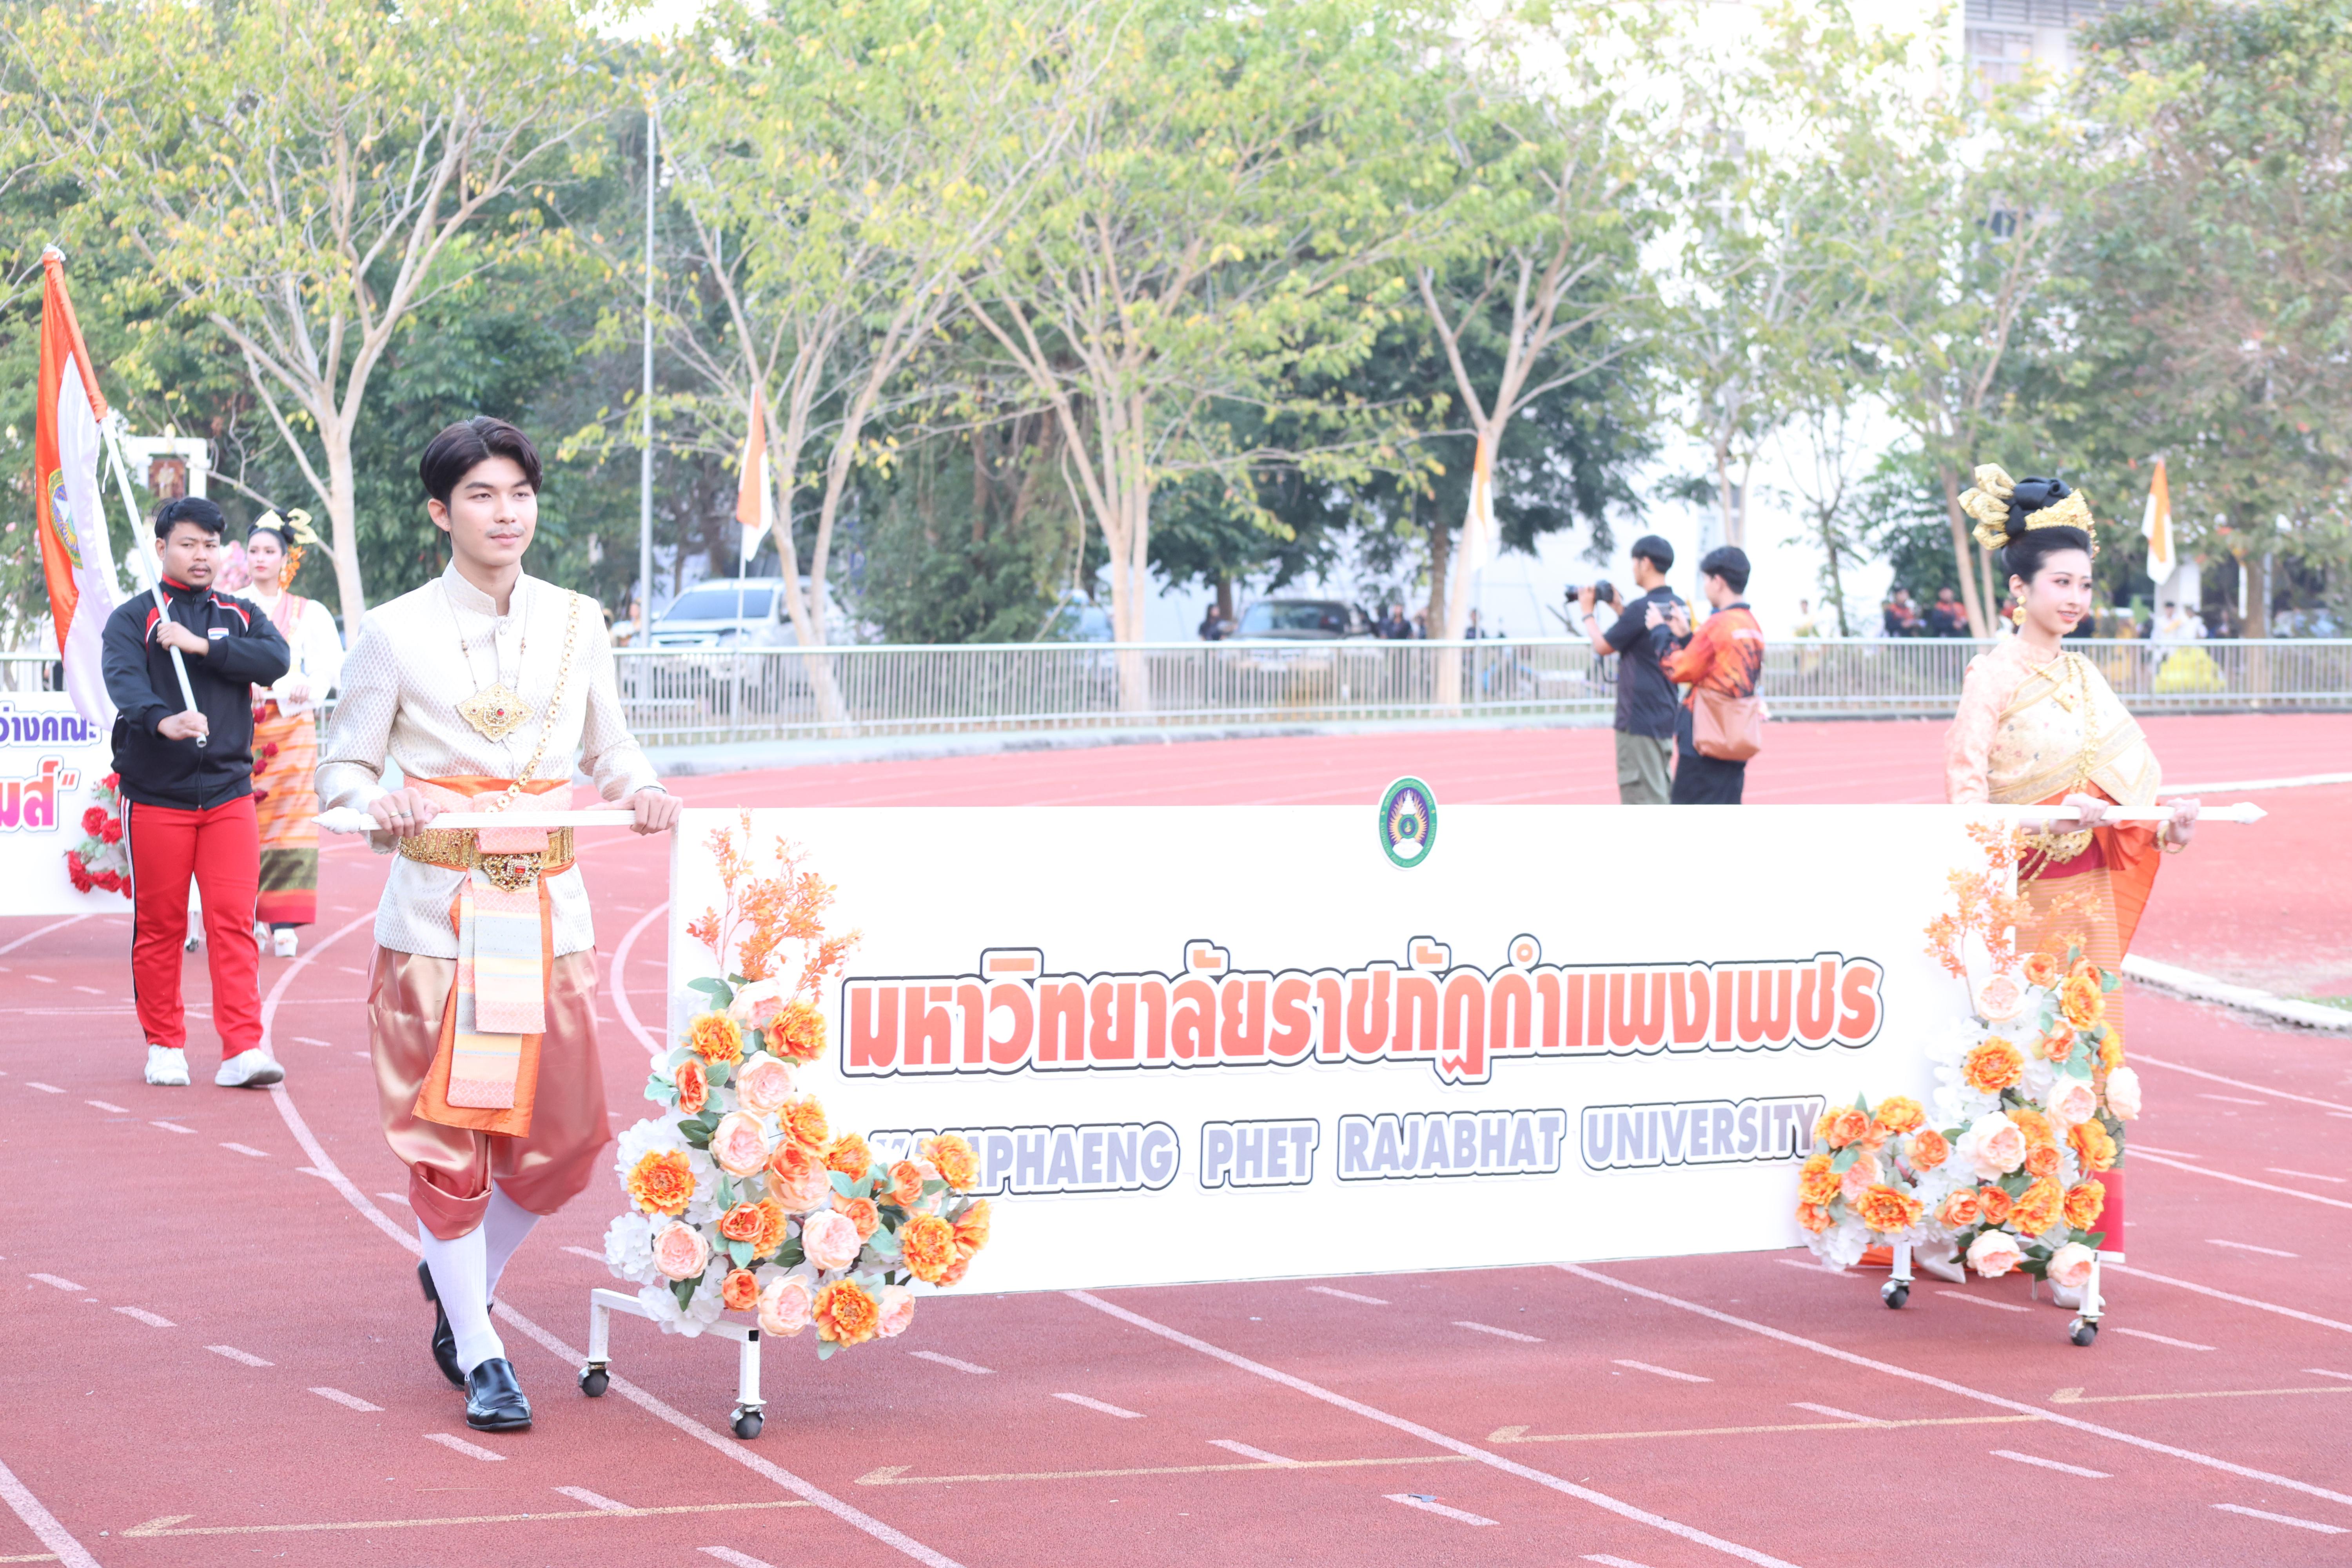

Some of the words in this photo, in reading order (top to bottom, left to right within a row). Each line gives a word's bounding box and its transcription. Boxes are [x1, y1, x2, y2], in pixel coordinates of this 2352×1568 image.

[849, 944, 1877, 1075] มหาวิทยาลัยราชภัฏกำแพงเพชร
[876, 1129, 1174, 1188] PHAENG
[1207, 1126, 1313, 1181] PHET
[1343, 1116, 1561, 1173] RAJABHAT
[1588, 1103, 1819, 1163] UNIVERSITY
